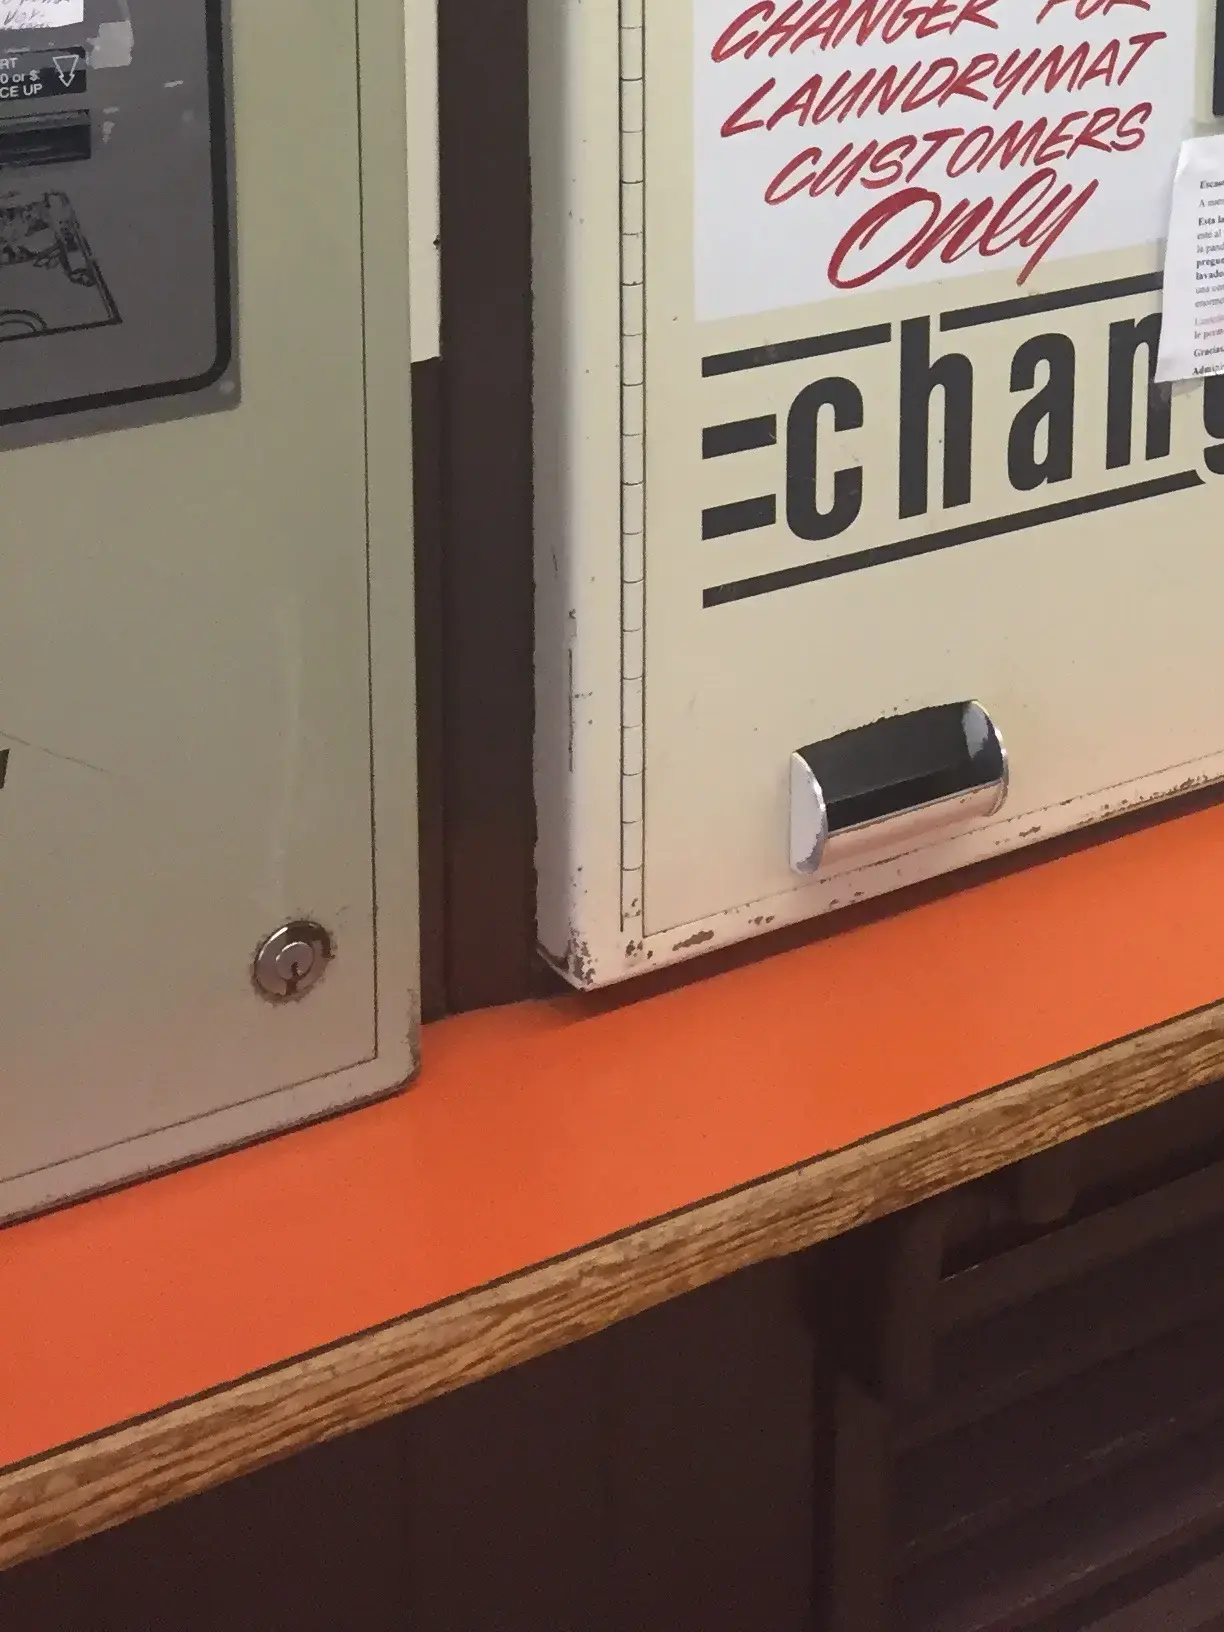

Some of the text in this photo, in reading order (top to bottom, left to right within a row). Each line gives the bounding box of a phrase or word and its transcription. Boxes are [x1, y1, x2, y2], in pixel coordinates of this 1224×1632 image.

[23, 83, 43, 96] UP
[720, 31, 1168, 138] LAUNDRYMAT
[764, 101, 1153, 206] CUSTOMERS
[827, 167, 1099, 290] Only
